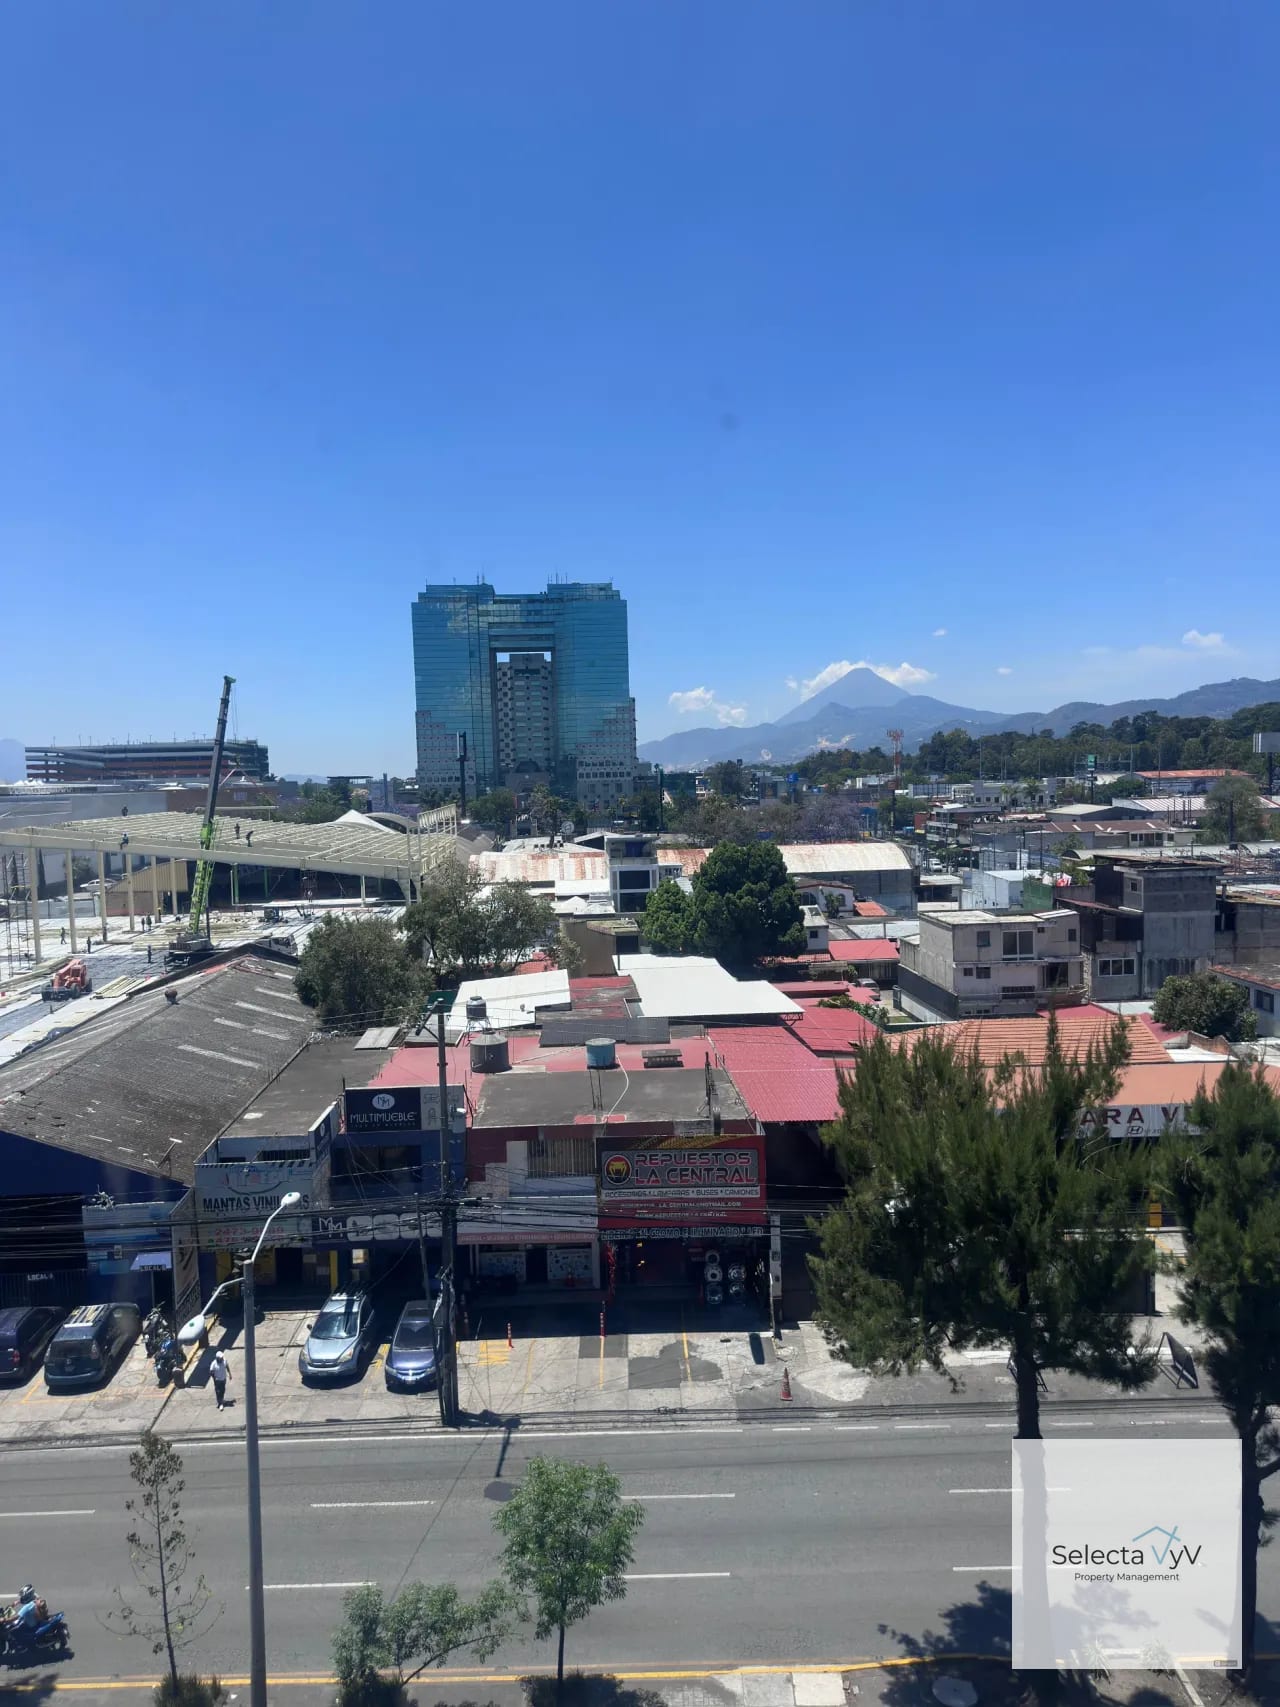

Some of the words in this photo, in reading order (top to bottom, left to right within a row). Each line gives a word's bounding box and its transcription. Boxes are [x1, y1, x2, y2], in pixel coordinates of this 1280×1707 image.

[350, 1112, 416, 1123] MULTIMUEBLE
[635, 1152, 751, 1167] REPUESTOS
[635, 1167, 661, 1185] LA
[666, 1166, 756, 1185] CENTRAL
[696, 1188, 719, 1196] BUSES
[724, 1188, 759, 1196] CAMIONES
[203, 1197, 250, 1212] MANTAS
